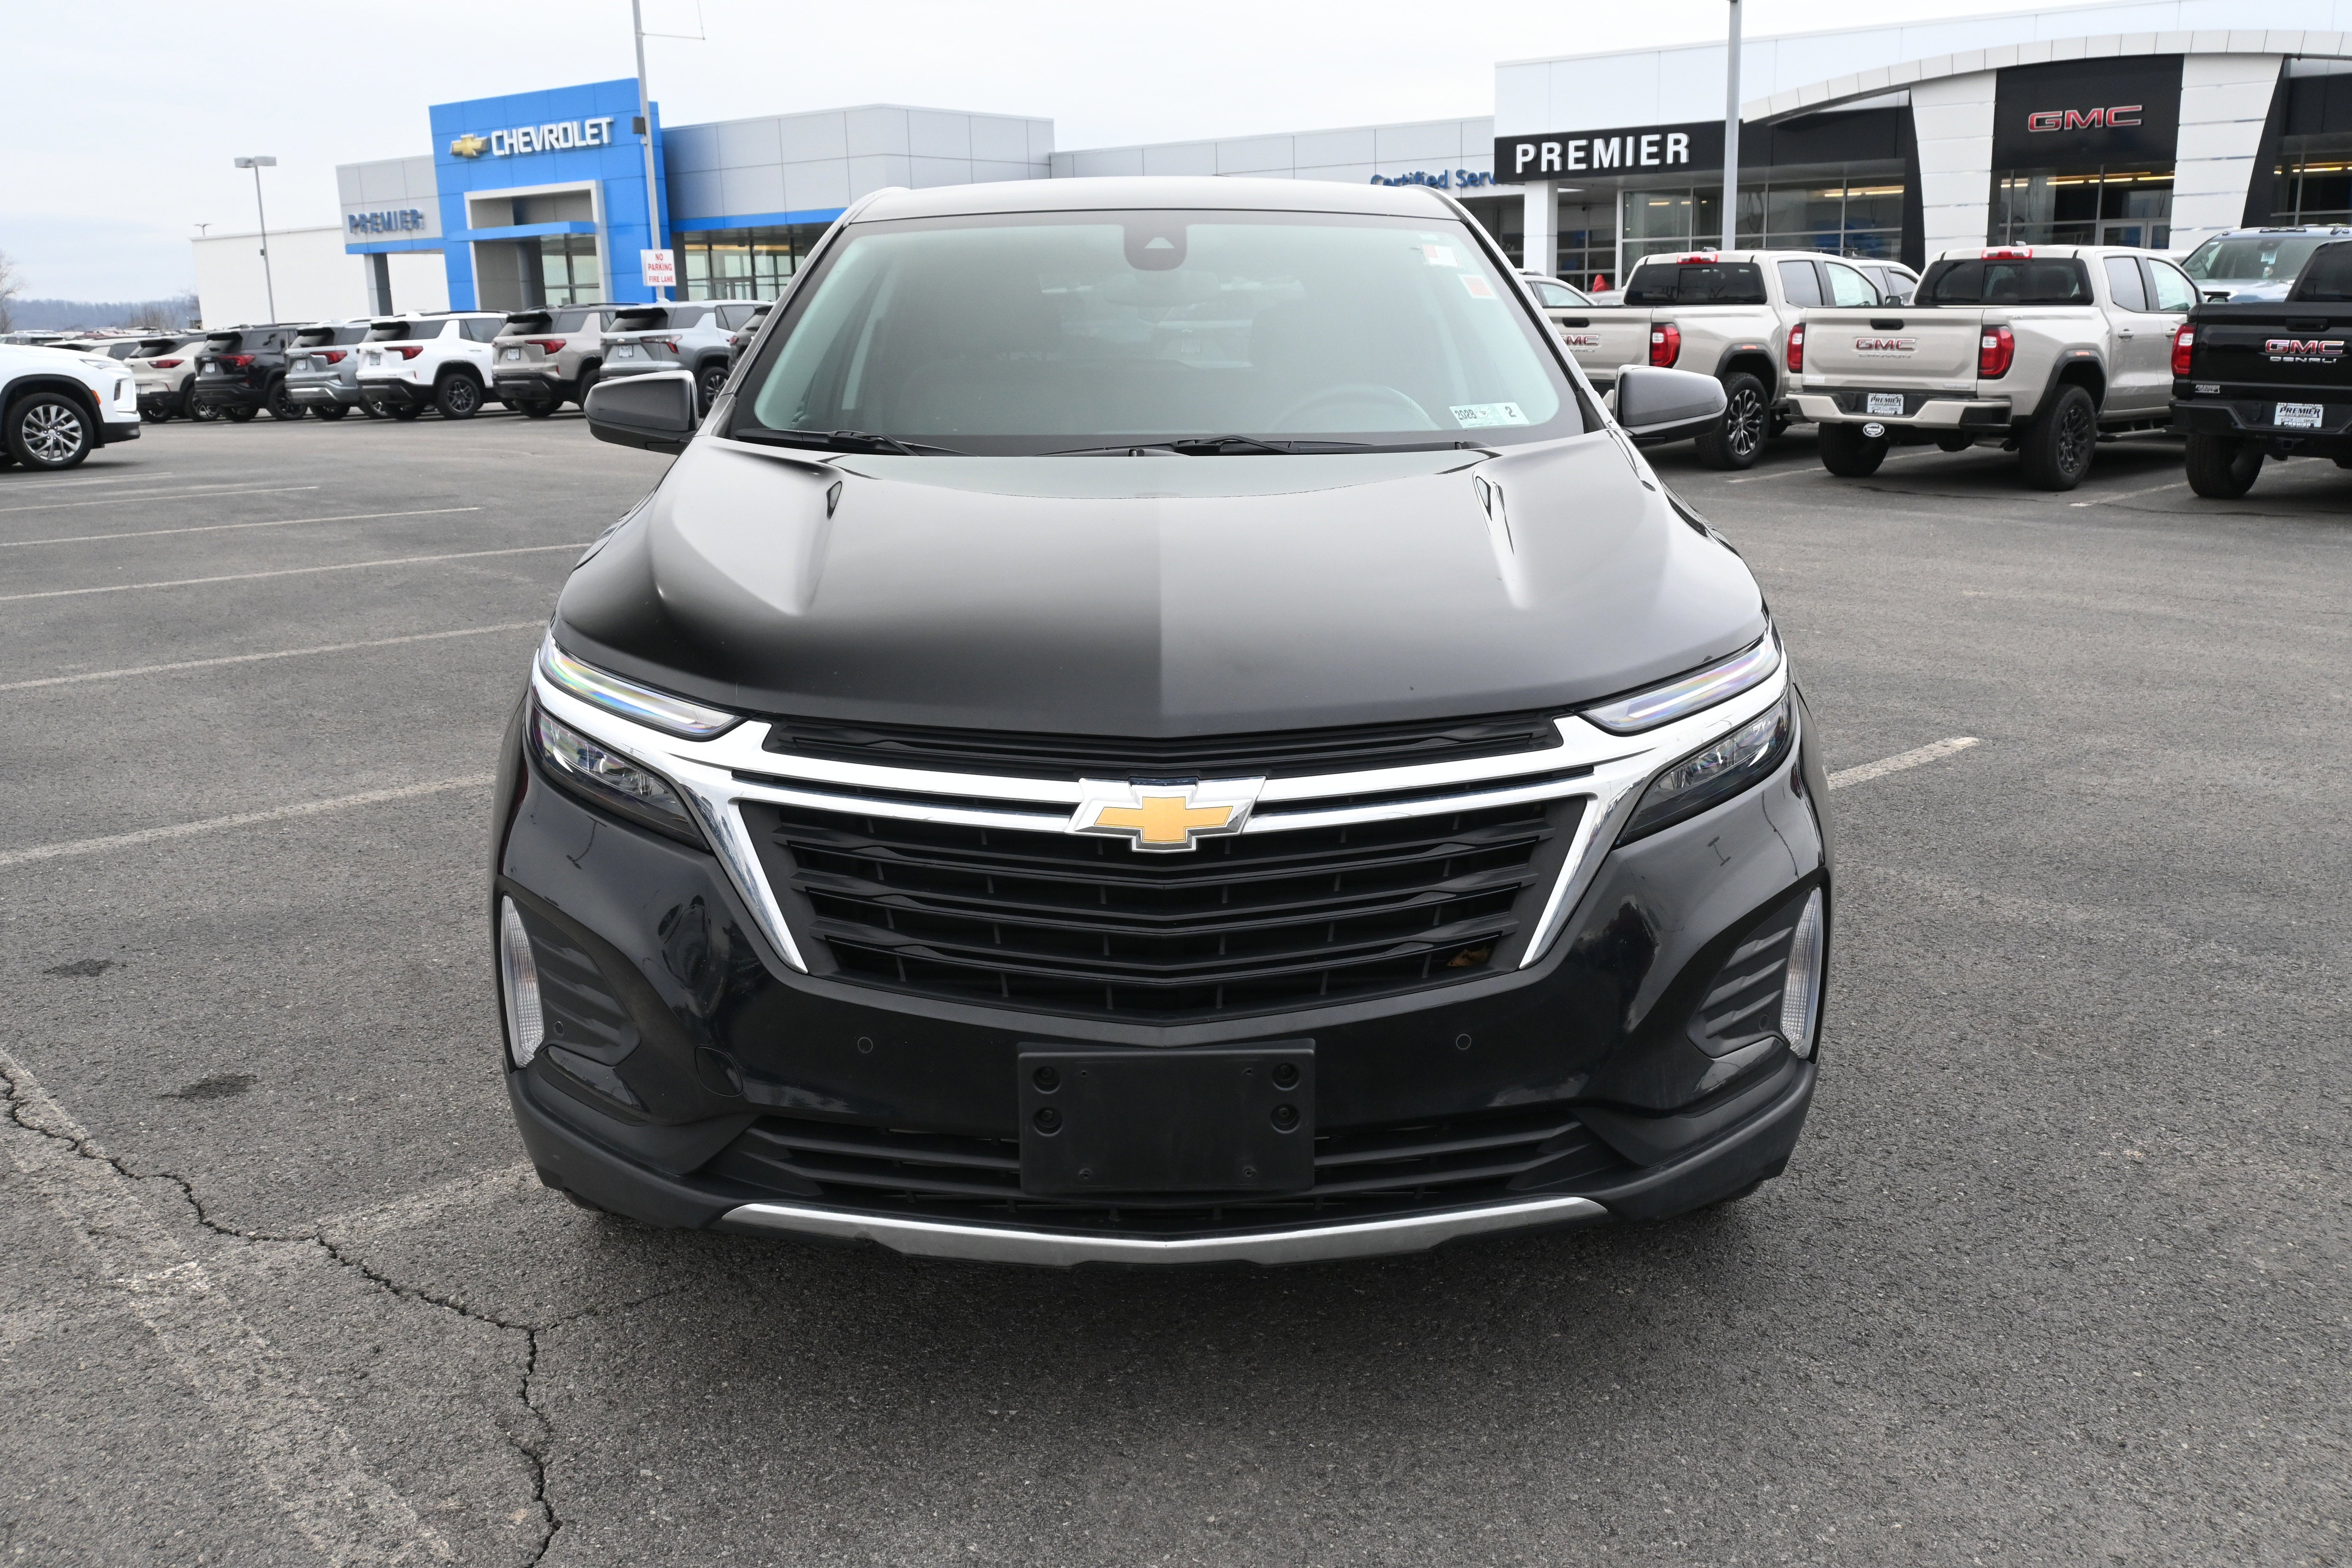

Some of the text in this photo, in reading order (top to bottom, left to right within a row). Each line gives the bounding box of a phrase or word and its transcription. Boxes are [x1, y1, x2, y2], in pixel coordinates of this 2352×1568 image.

[2028, 105, 2142, 132] GMC
[491, 117, 614, 156] CHEVROLET
[1516, 132, 1689, 174] PREMIER
[1370, 169, 1495, 188] Certified Serv
[348, 209, 423, 233] PREMIER
[1856, 338, 1915, 351] GMC
[2265, 339, 2344, 354] GMC
[1870, 397, 1901, 406] PREMIER
[1454, 409, 1477, 420] 2028
[1505, 406, 1516, 417] 2
[2280, 407, 2320, 418] PREMIER
